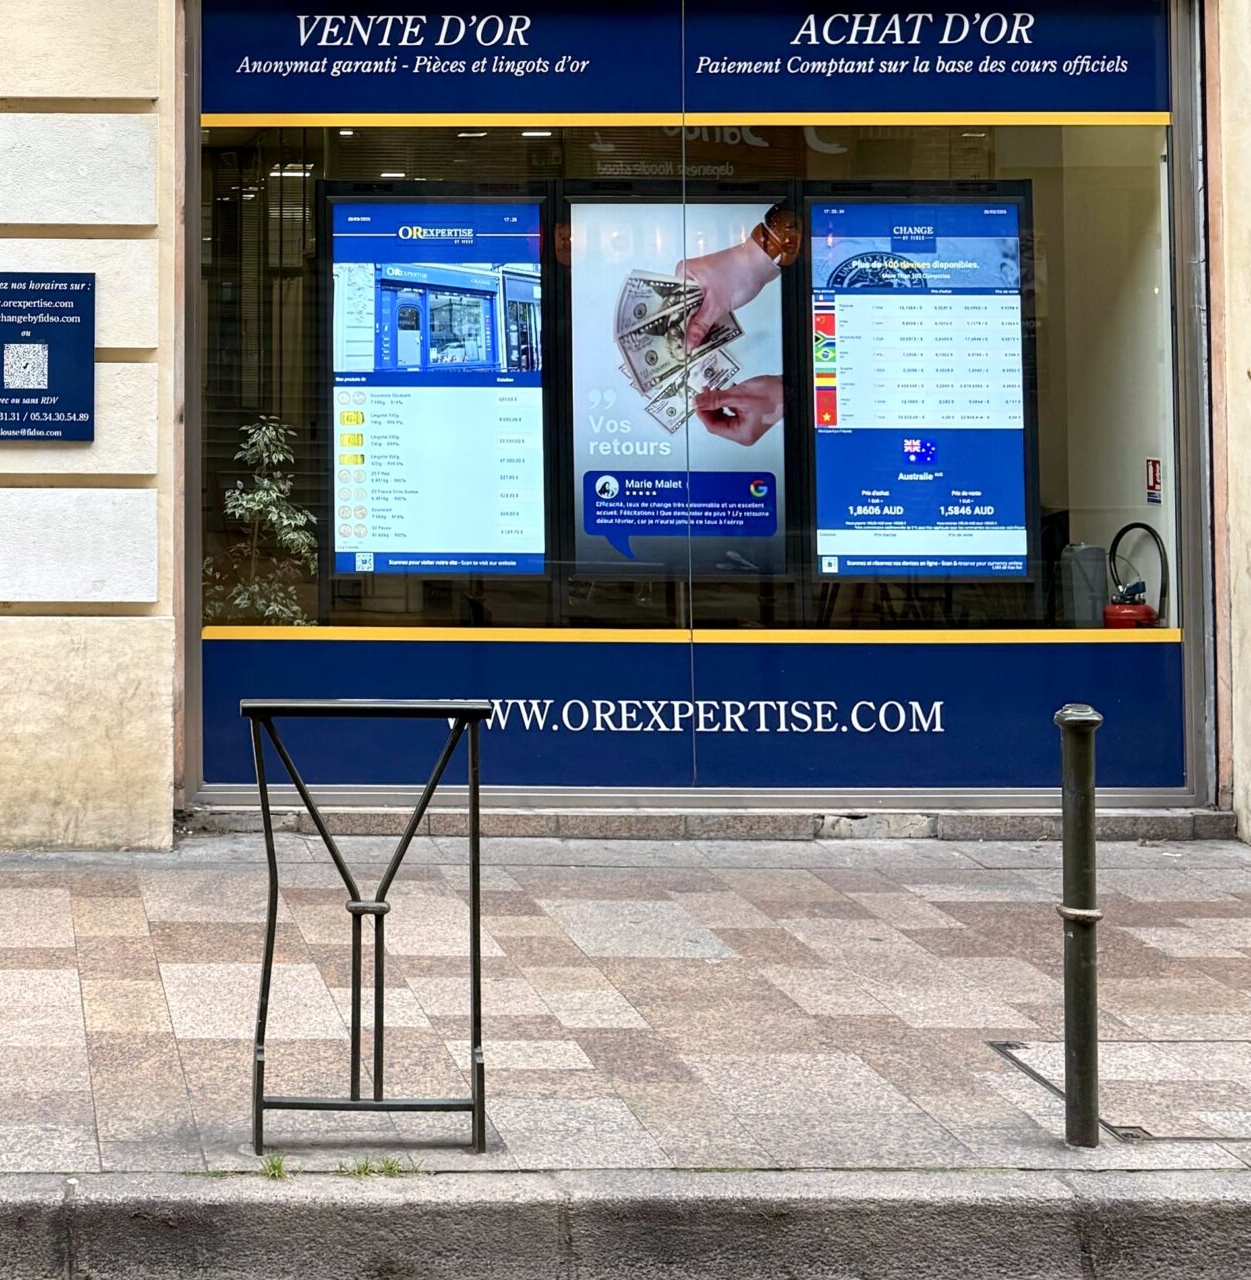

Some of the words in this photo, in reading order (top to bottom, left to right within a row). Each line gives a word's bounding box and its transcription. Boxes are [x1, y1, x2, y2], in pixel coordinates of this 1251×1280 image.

[297, 16, 427, 46] VENTE
[436, 16, 531, 46] D'OR
[791, 14, 933, 45] ACHAT
[939, 13, 1035, 45] D'OR
[236, 56, 327, 74] Anonymat
[330, 56, 398, 76] garanti
[413, 55, 465, 73] Pièces
[471, 58, 487, 73] et
[492, 56, 548, 76] lingots
[554, 56, 589, 73] d'or
[696, 56, 781, 74] Paiement
[787, 56, 874, 76] Comptant
[879, 61, 908, 74] sur
[913, 56, 930, 73] la
[936, 56, 973, 73] base
[978, 55, 1006, 73] des
[1011, 60, 1057, 73] cours
[1062, 55, 1129, 76] officiels
[11, 282, 26, 290] nos
[29, 280, 68, 290] horaires
[41, 396, 59, 405] RDV
[589, 416, 632, 433] Vos
[589, 438, 672, 456] retours
[898, 472, 933, 481] Australie
[625, 480, 653, 489] Marie
[655, 480, 682, 489] Malet
[848, 506, 881, 517] 1,8606
[883, 506, 904, 515] AUD
[939, 506, 972, 517] 1,5846
[973, 506, 994, 515] AUD
